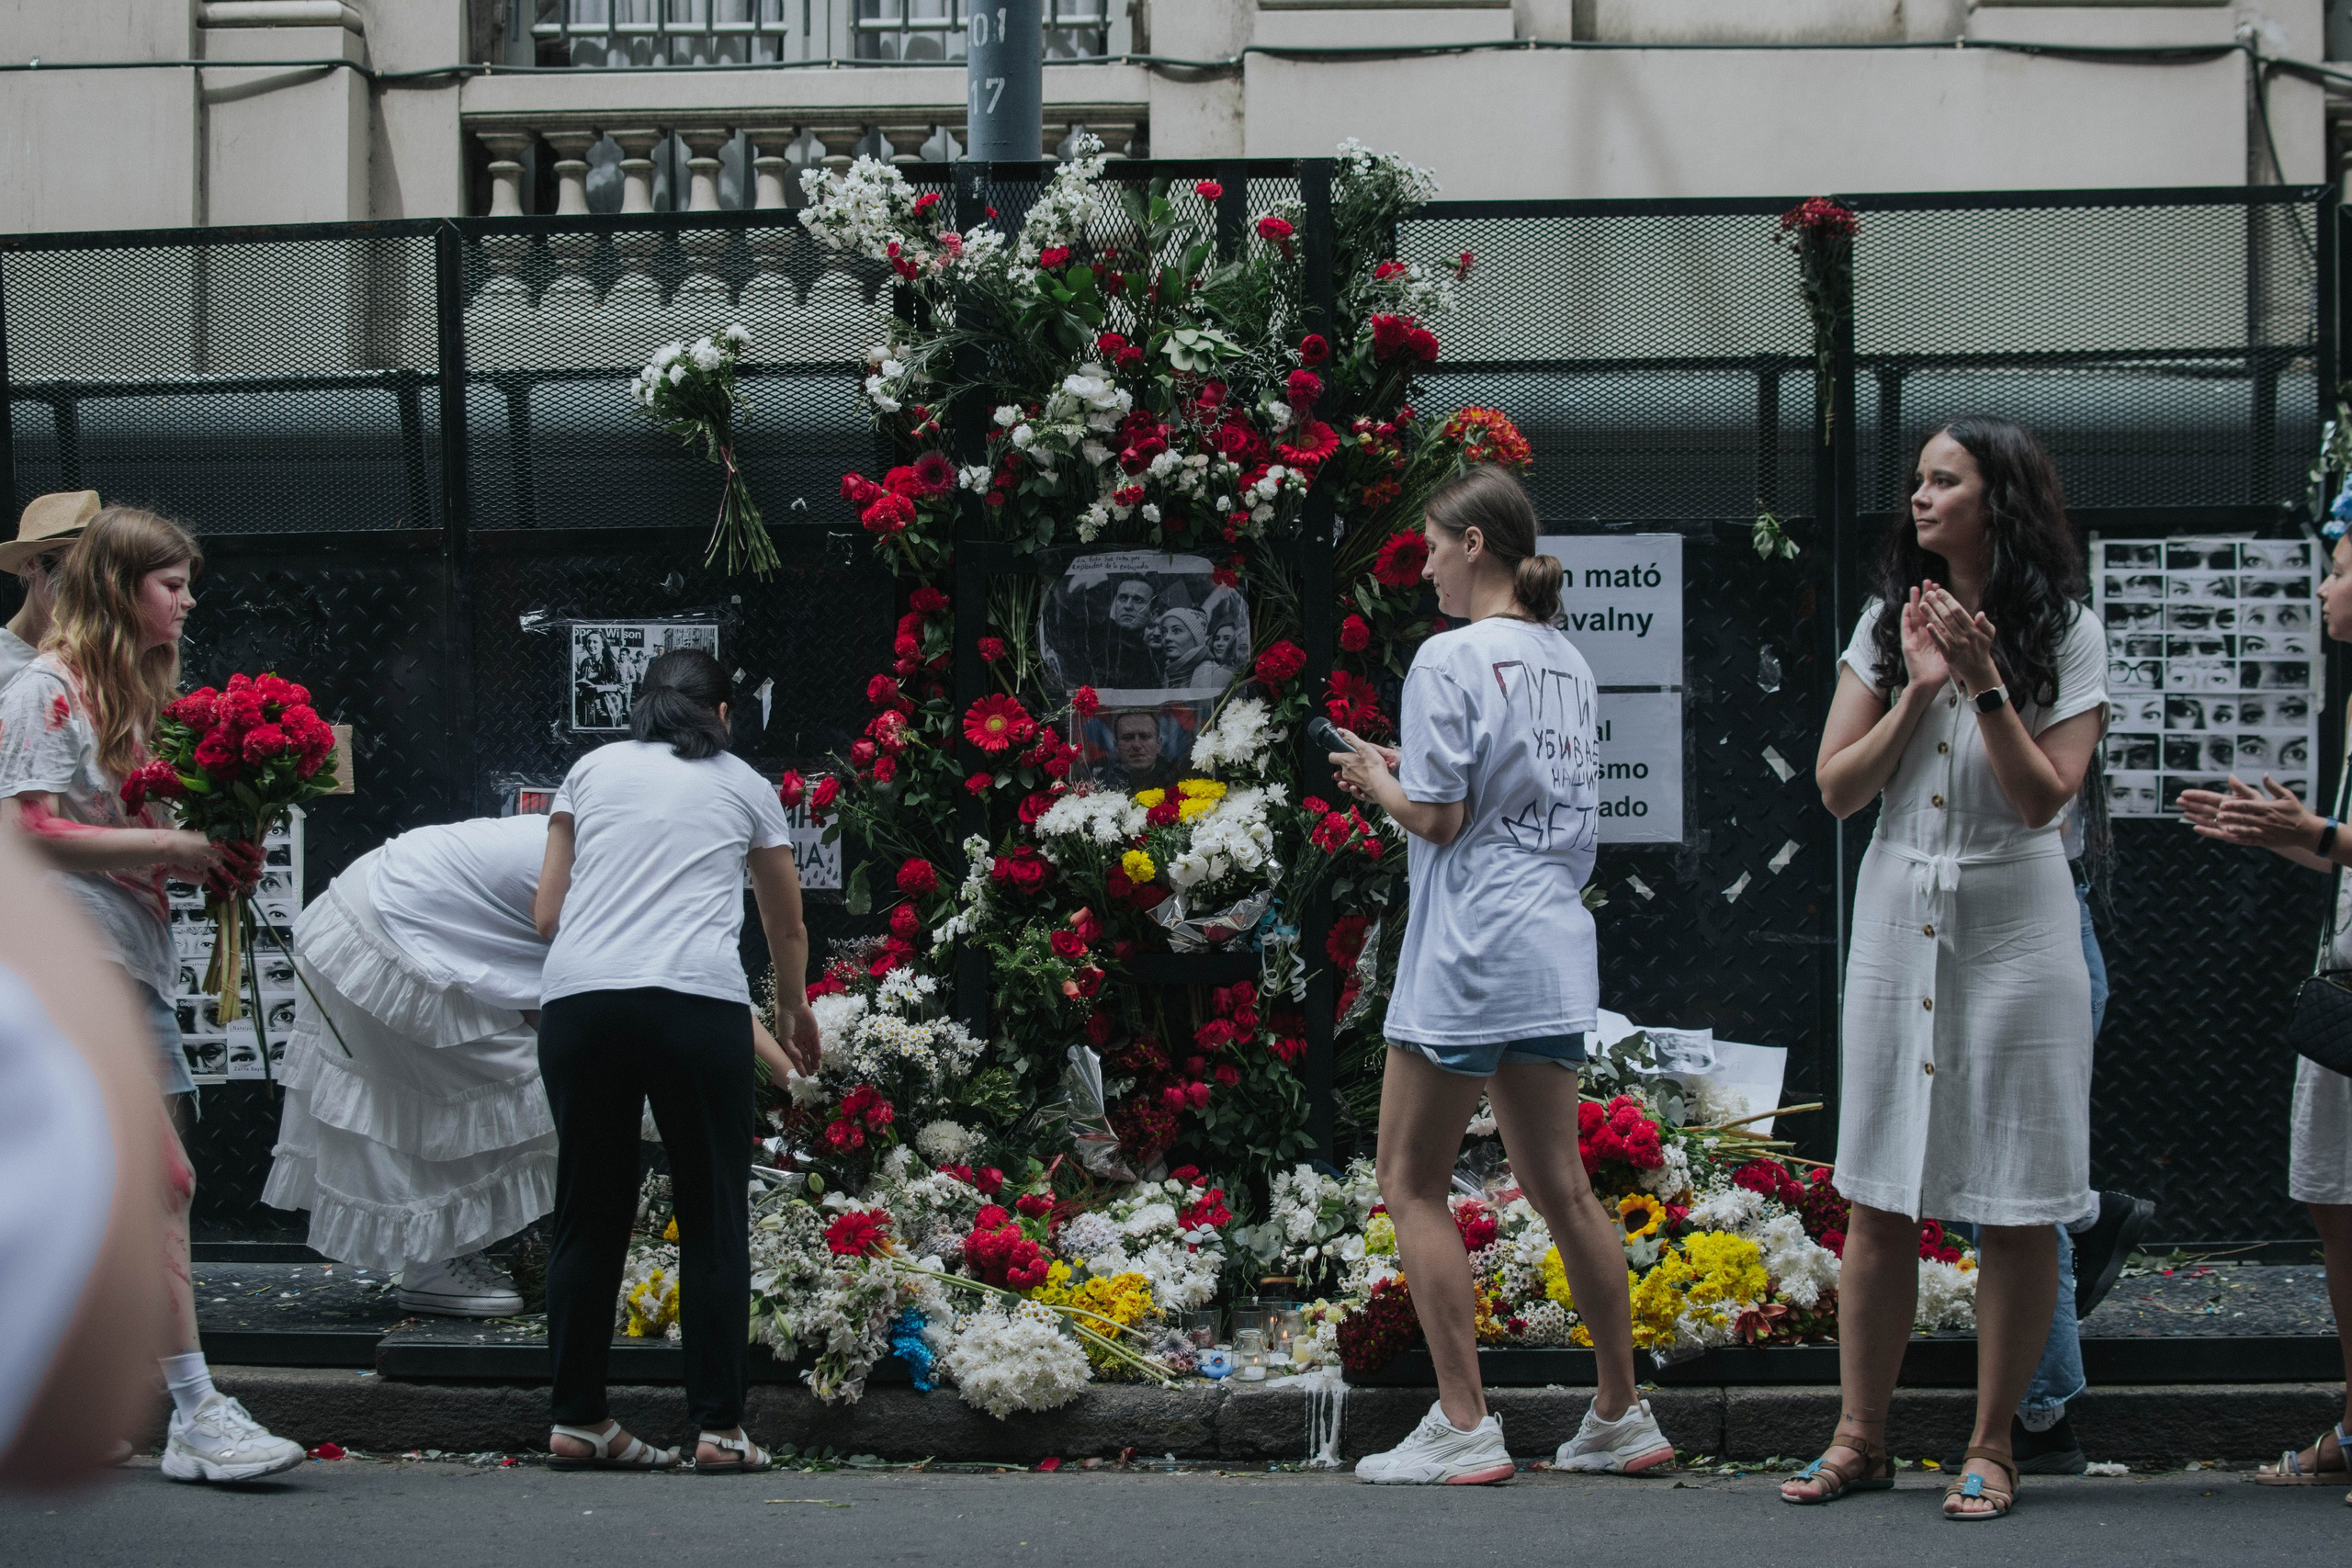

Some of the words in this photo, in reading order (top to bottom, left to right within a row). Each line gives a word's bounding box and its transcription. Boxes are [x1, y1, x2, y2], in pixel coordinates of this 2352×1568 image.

[970, 77, 1006, 116] 17
[1585, 562, 1661, 588] mató
[1599, 795, 1648, 818] ado
